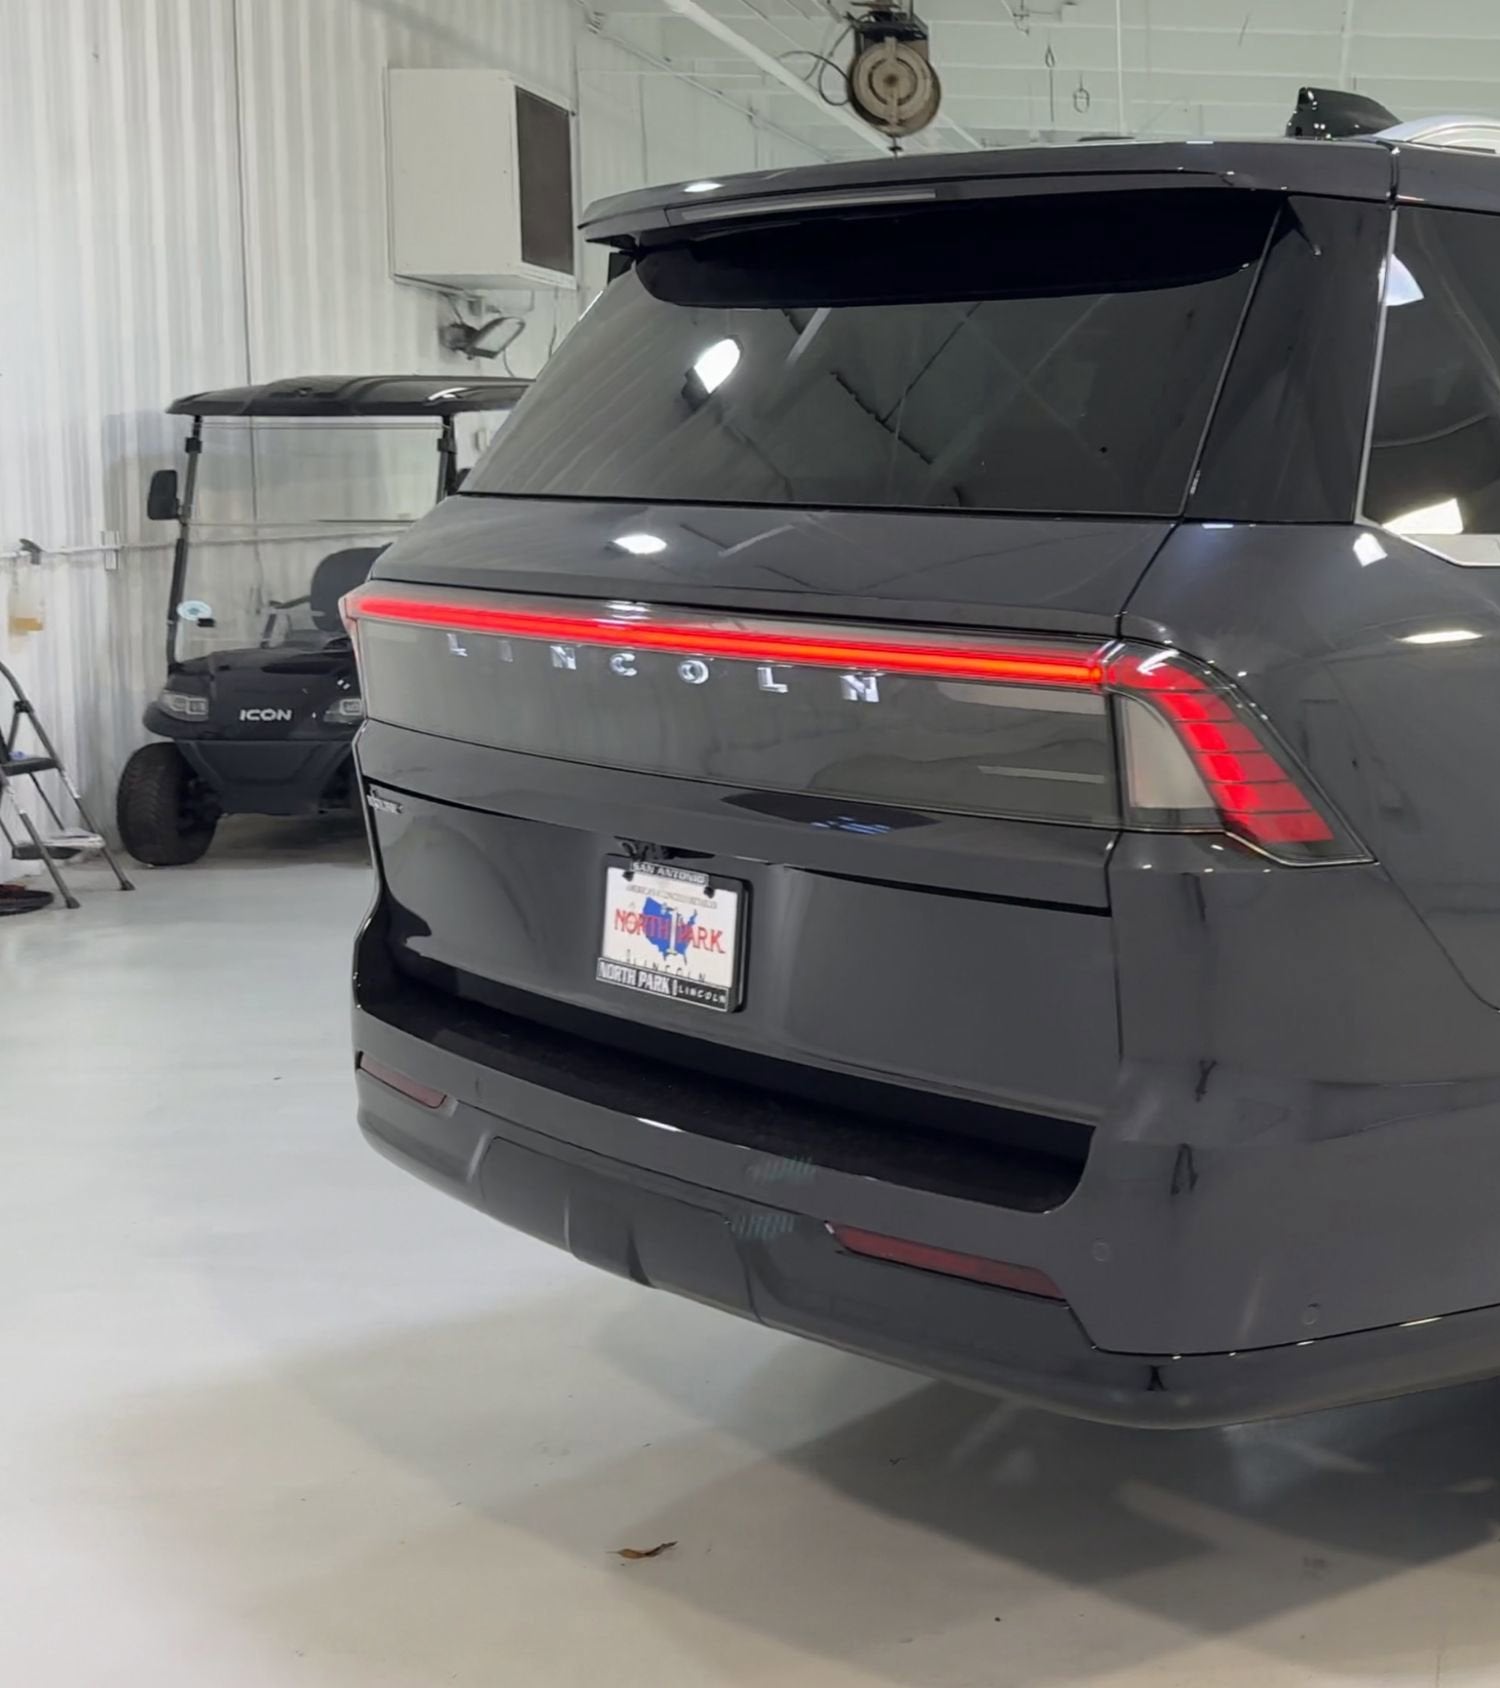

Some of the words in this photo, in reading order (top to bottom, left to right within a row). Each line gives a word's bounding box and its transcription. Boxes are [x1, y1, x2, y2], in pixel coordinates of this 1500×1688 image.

[448, 632, 881, 703] LINCOLN
[239, 708, 292, 721] ICON
[632, 861, 654, 875] SAN
[656, 866, 706, 884] ANTONIO
[599, 961, 637, 986] NORTH
[638, 970, 671, 996] PARK
[678, 984, 727, 1004] LINCOLN
